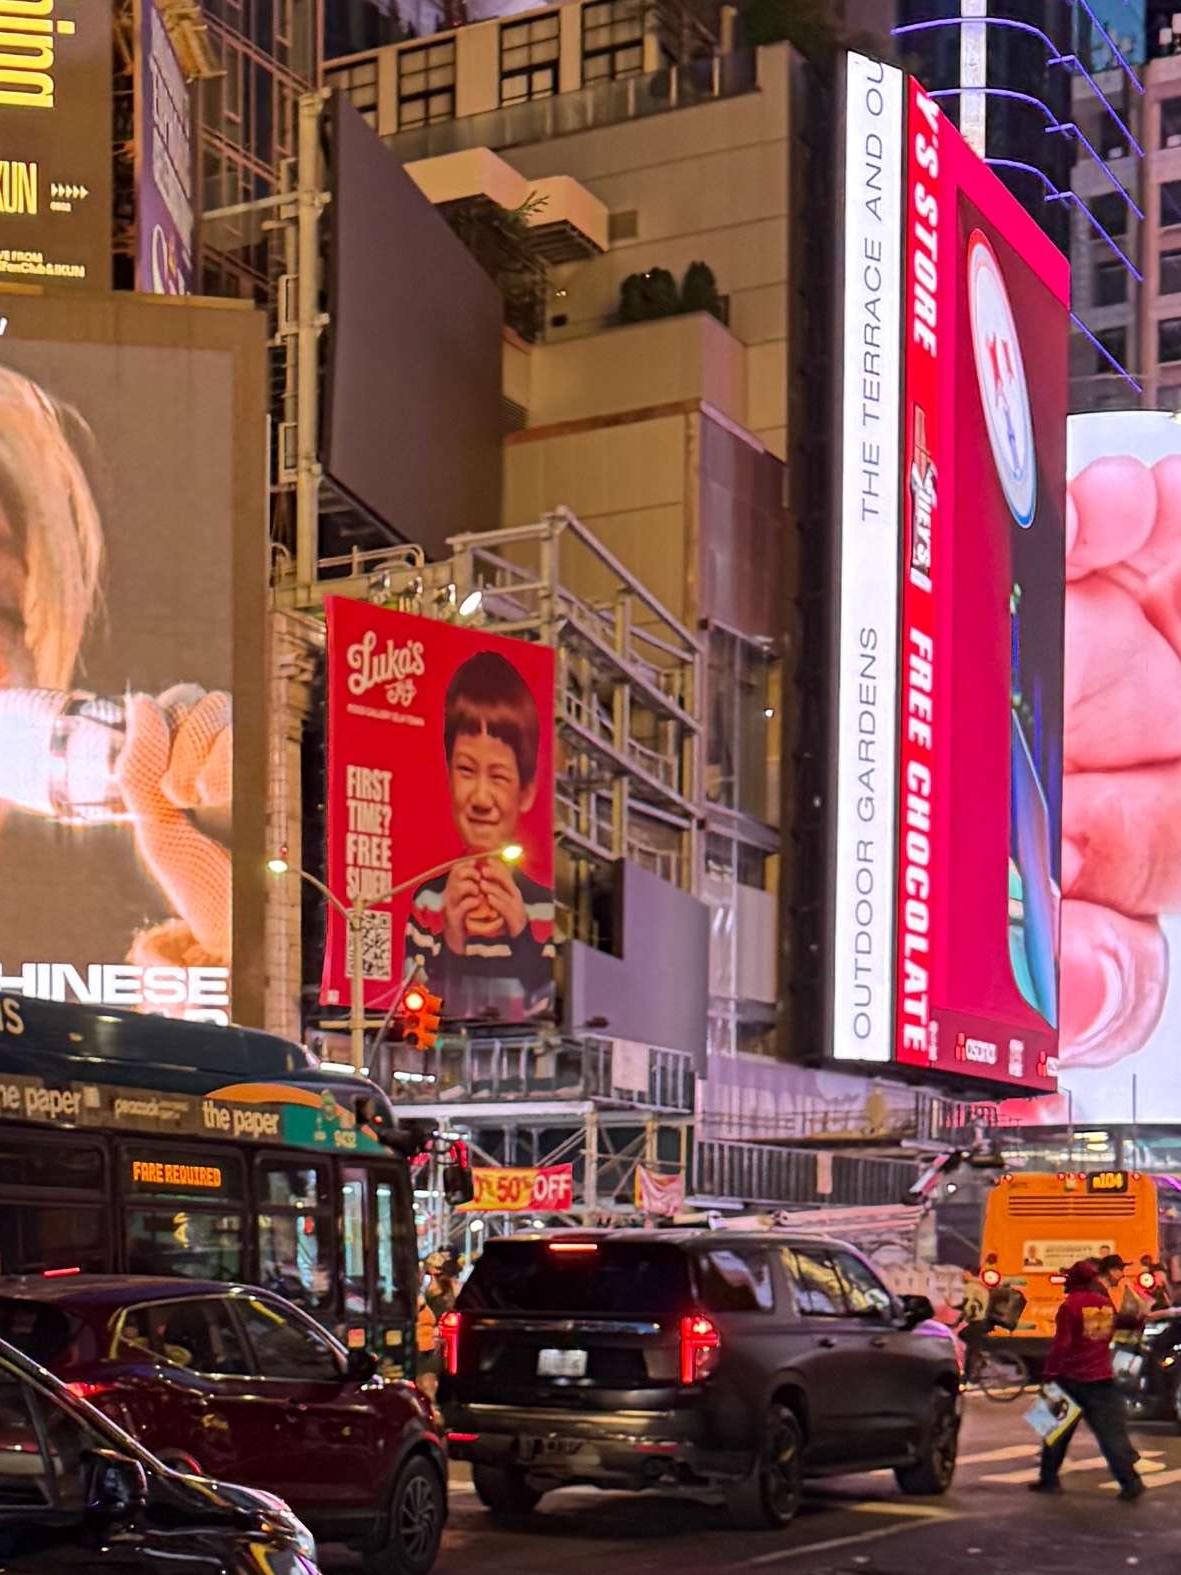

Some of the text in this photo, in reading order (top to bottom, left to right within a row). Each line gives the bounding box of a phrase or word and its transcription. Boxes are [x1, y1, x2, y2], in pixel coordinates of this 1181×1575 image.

[865, 133, 883, 221] AND
[913, 182, 938, 357] STORE
[863, 237, 882, 426] TERRACE
[861, 441, 879, 522] THE
[347, 630, 425, 695] Luka's
[909, 627, 933, 750] FREE
[856, 627, 877, 823] GARDENS
[346, 765, 392, 802] FIRST
[346, 800, 392, 836] TIME?
[346, 832, 392, 869] FREE
[854, 838, 874, 1040] OUTDOOR
[903, 760, 931, 1053] CHOCOLATE
[24, 1086, 82, 1119] paper
[202, 1100, 230, 1130] the
[233, 1108, 281, 1139] paper
[133, 1161, 222, 1188] FARE REQUIRED
[533, 1174, 570, 1201] OFF
